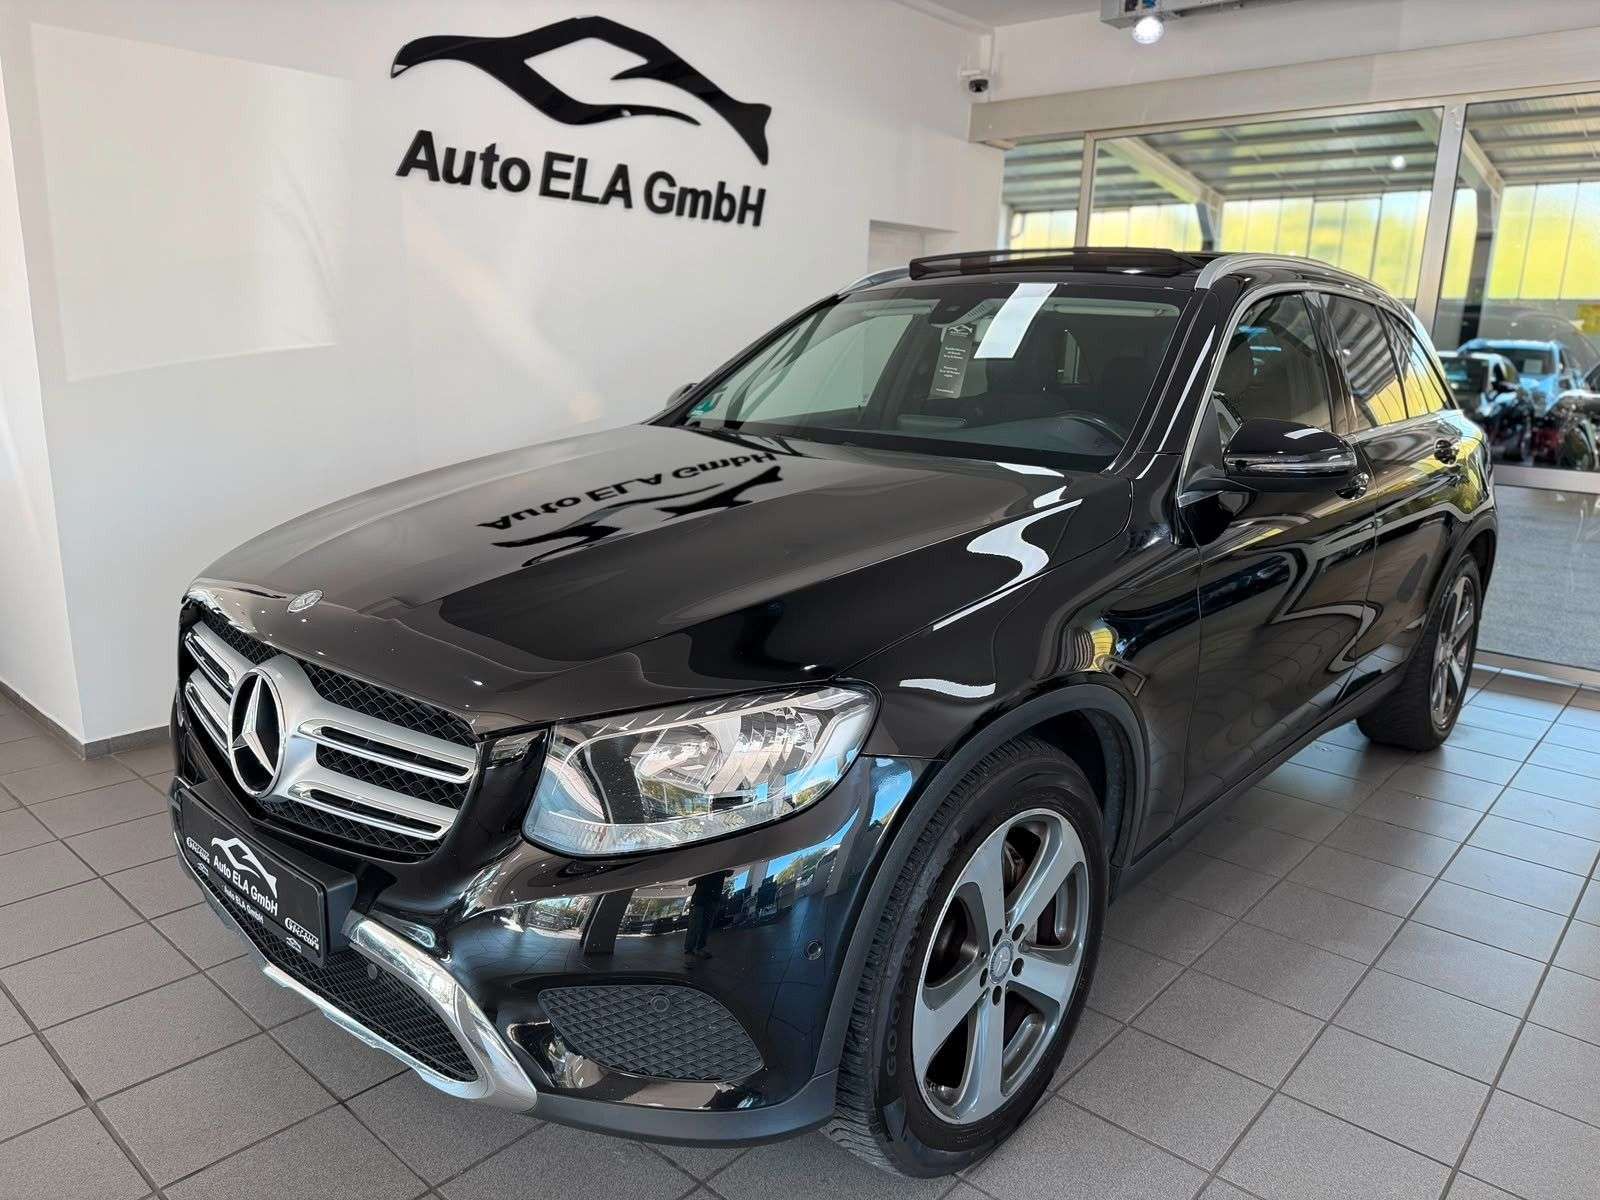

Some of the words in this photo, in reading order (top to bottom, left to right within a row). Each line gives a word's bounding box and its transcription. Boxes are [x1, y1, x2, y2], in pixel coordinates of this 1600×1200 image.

[396, 129, 531, 193] Auto
[538, 151, 633, 209] ELA
[644, 170, 766, 227] GmbH
[213, 855, 231, 879] Auto
[232, 869, 249, 895] ELA
[250, 885, 278, 917] GmbH
